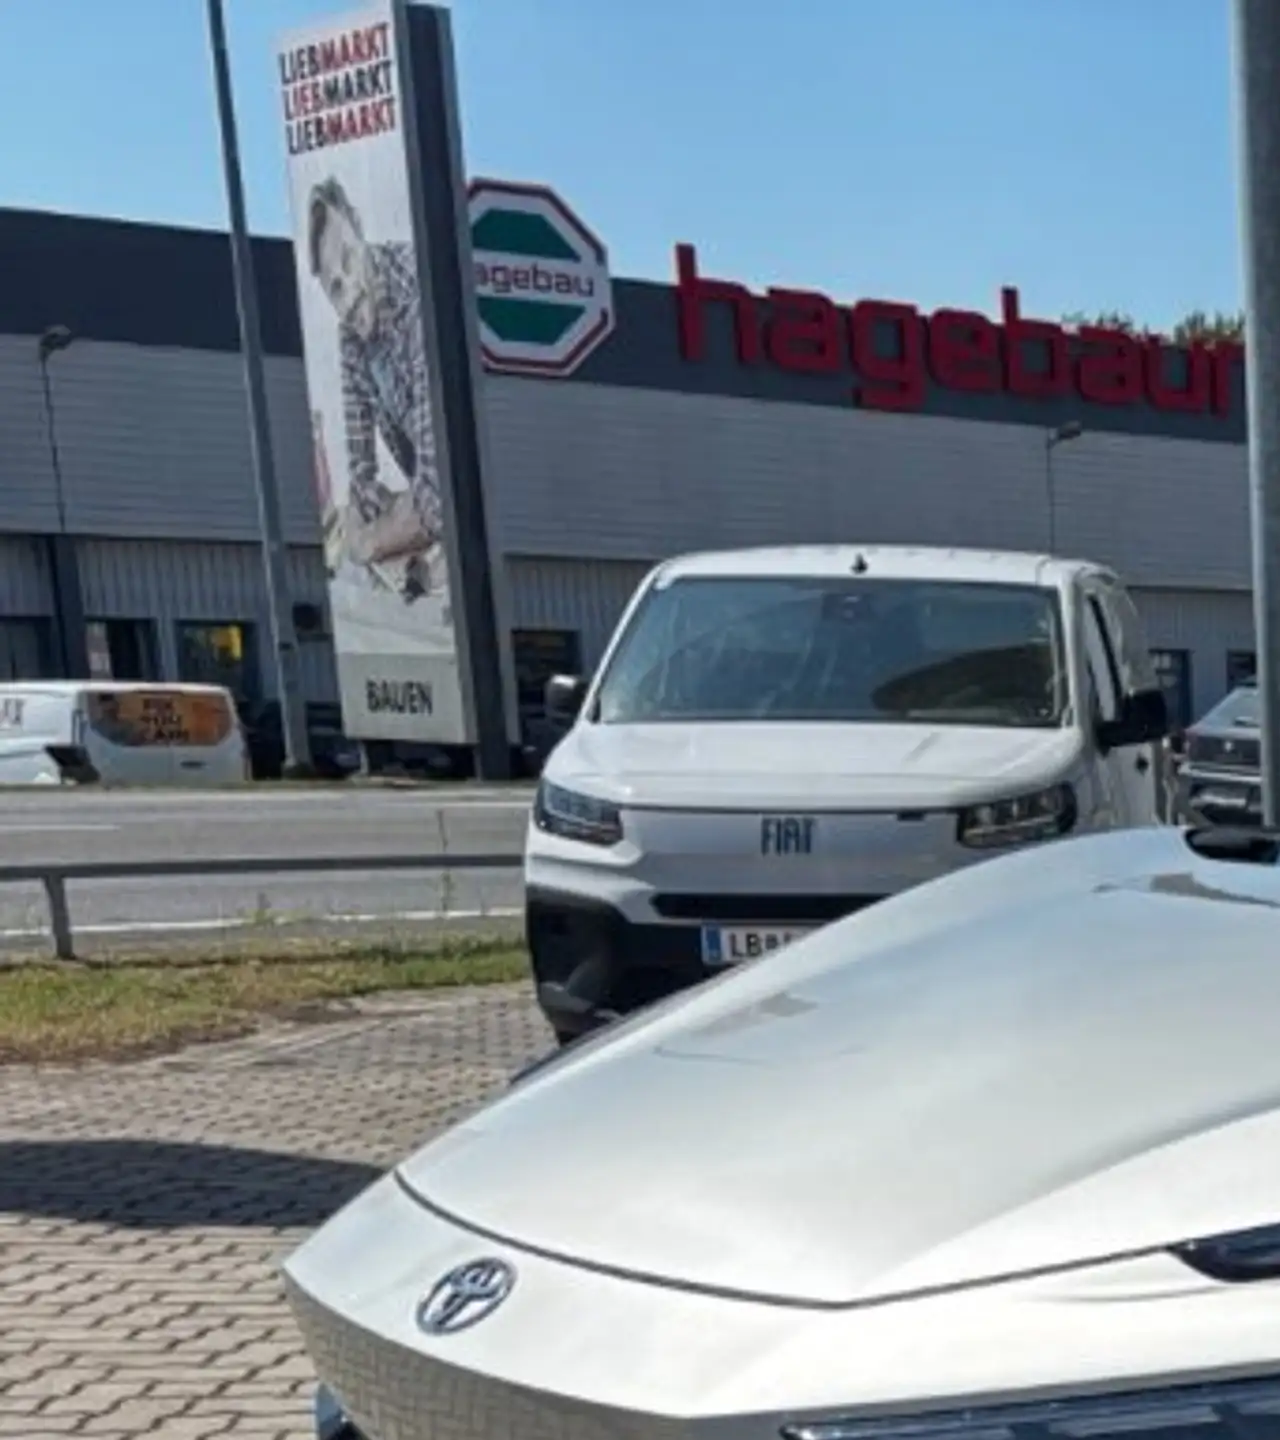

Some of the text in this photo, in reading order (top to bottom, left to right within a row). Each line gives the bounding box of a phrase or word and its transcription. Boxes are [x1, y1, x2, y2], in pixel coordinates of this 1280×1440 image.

[278, 22, 389, 85] LIEBMARKT
[283, 58, 392, 121] LIEBMARKT
[286, 96, 396, 156] LIEBMARKT
[476, 261, 594, 297] agebau
[366, 680, 433, 716] BAUEN
[761, 817, 815, 856] FIAT
